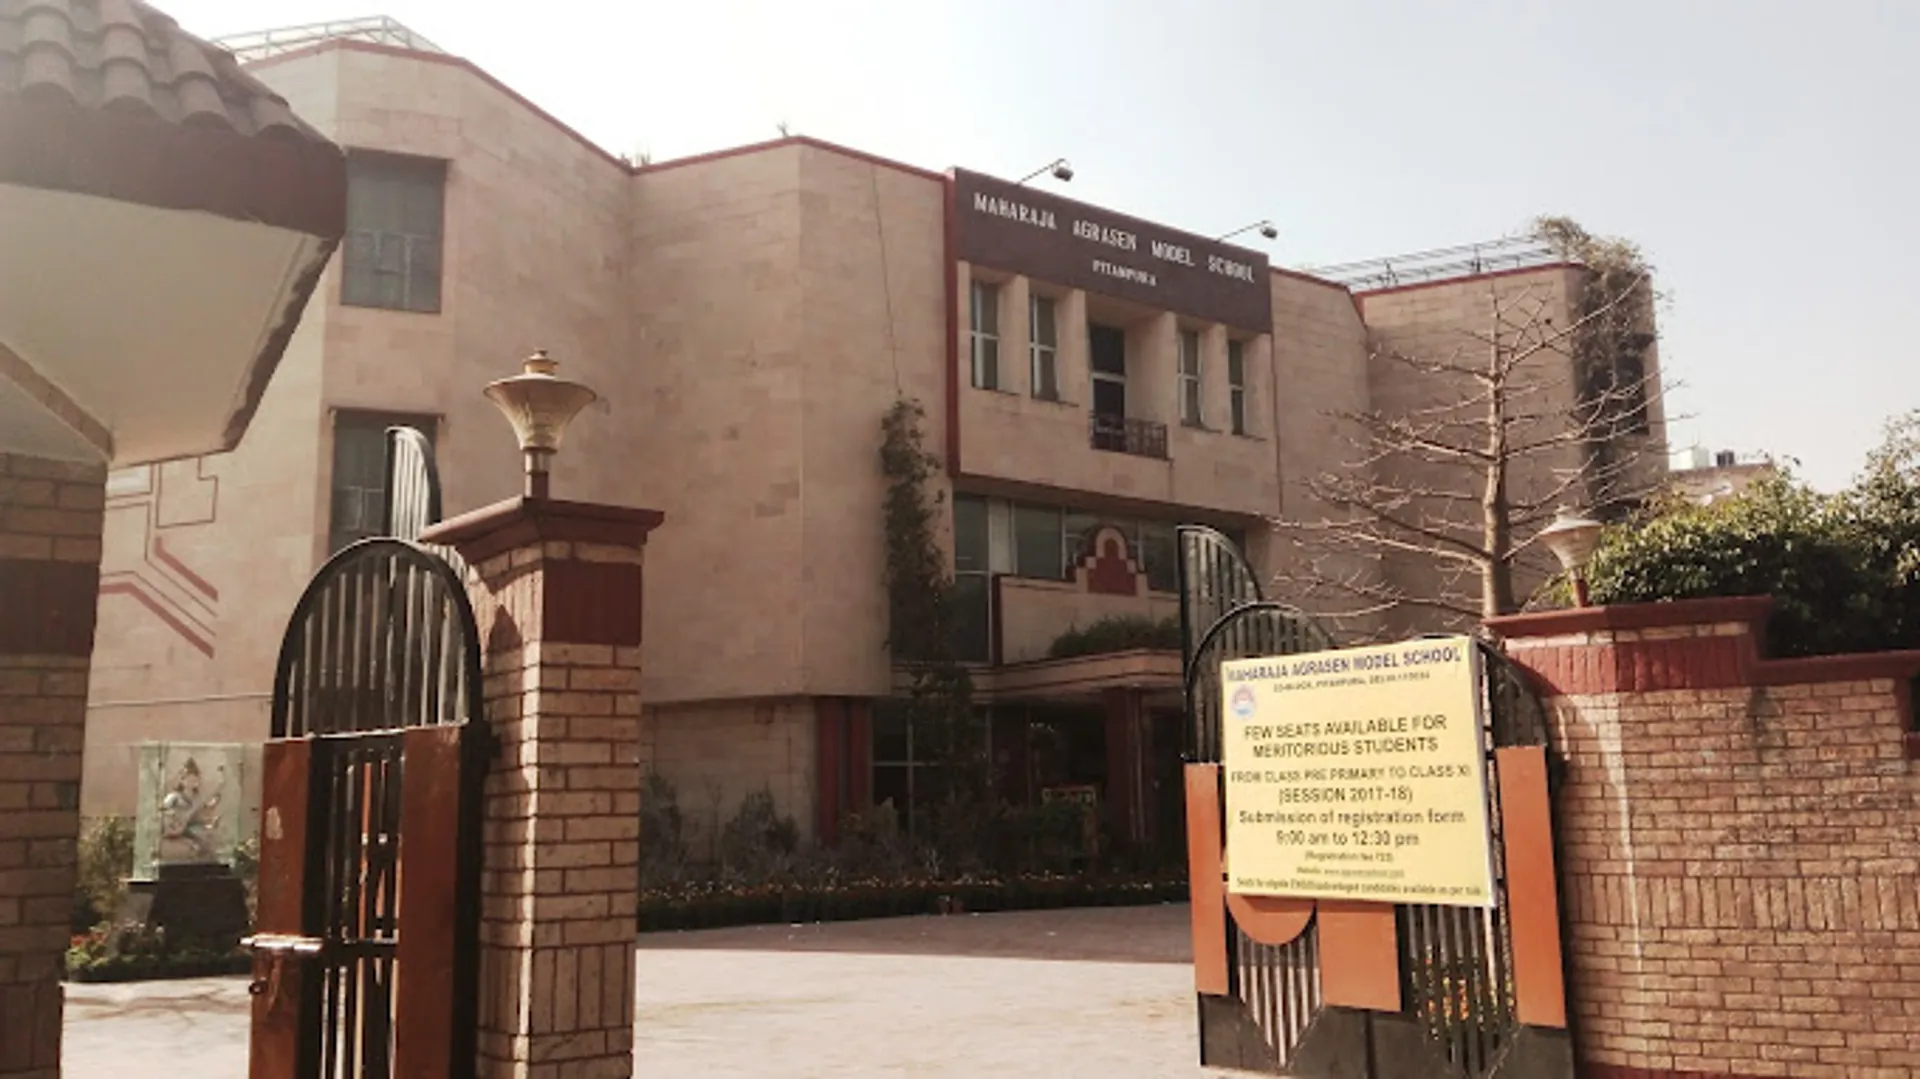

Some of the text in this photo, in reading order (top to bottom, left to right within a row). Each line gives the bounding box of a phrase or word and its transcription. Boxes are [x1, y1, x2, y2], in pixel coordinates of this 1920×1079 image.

[974, 192, 1255, 284] MAHARAJA AGRASEN MODEL SCHOOL
[1092, 259, 1157, 287] PITAMPURA
[1227, 645, 1462, 682] MAHARAJA AGRASEN MODEL SCHOOL
[1244, 713, 1448, 740] FEW SEATS AVAILABLE FOR
[1253, 736, 1439, 759] MERITORIOUS STUDENTS
[1230, 764, 1472, 783] FROM CLASS PRE PRIMARY TO CLASS XI
[1279, 785, 1414, 804] (SESSION 2017-18)
[1239, 808, 1466, 828] Submission of registration form
[1276, 831, 1420, 848] 9:00 am to 12:30 pm
